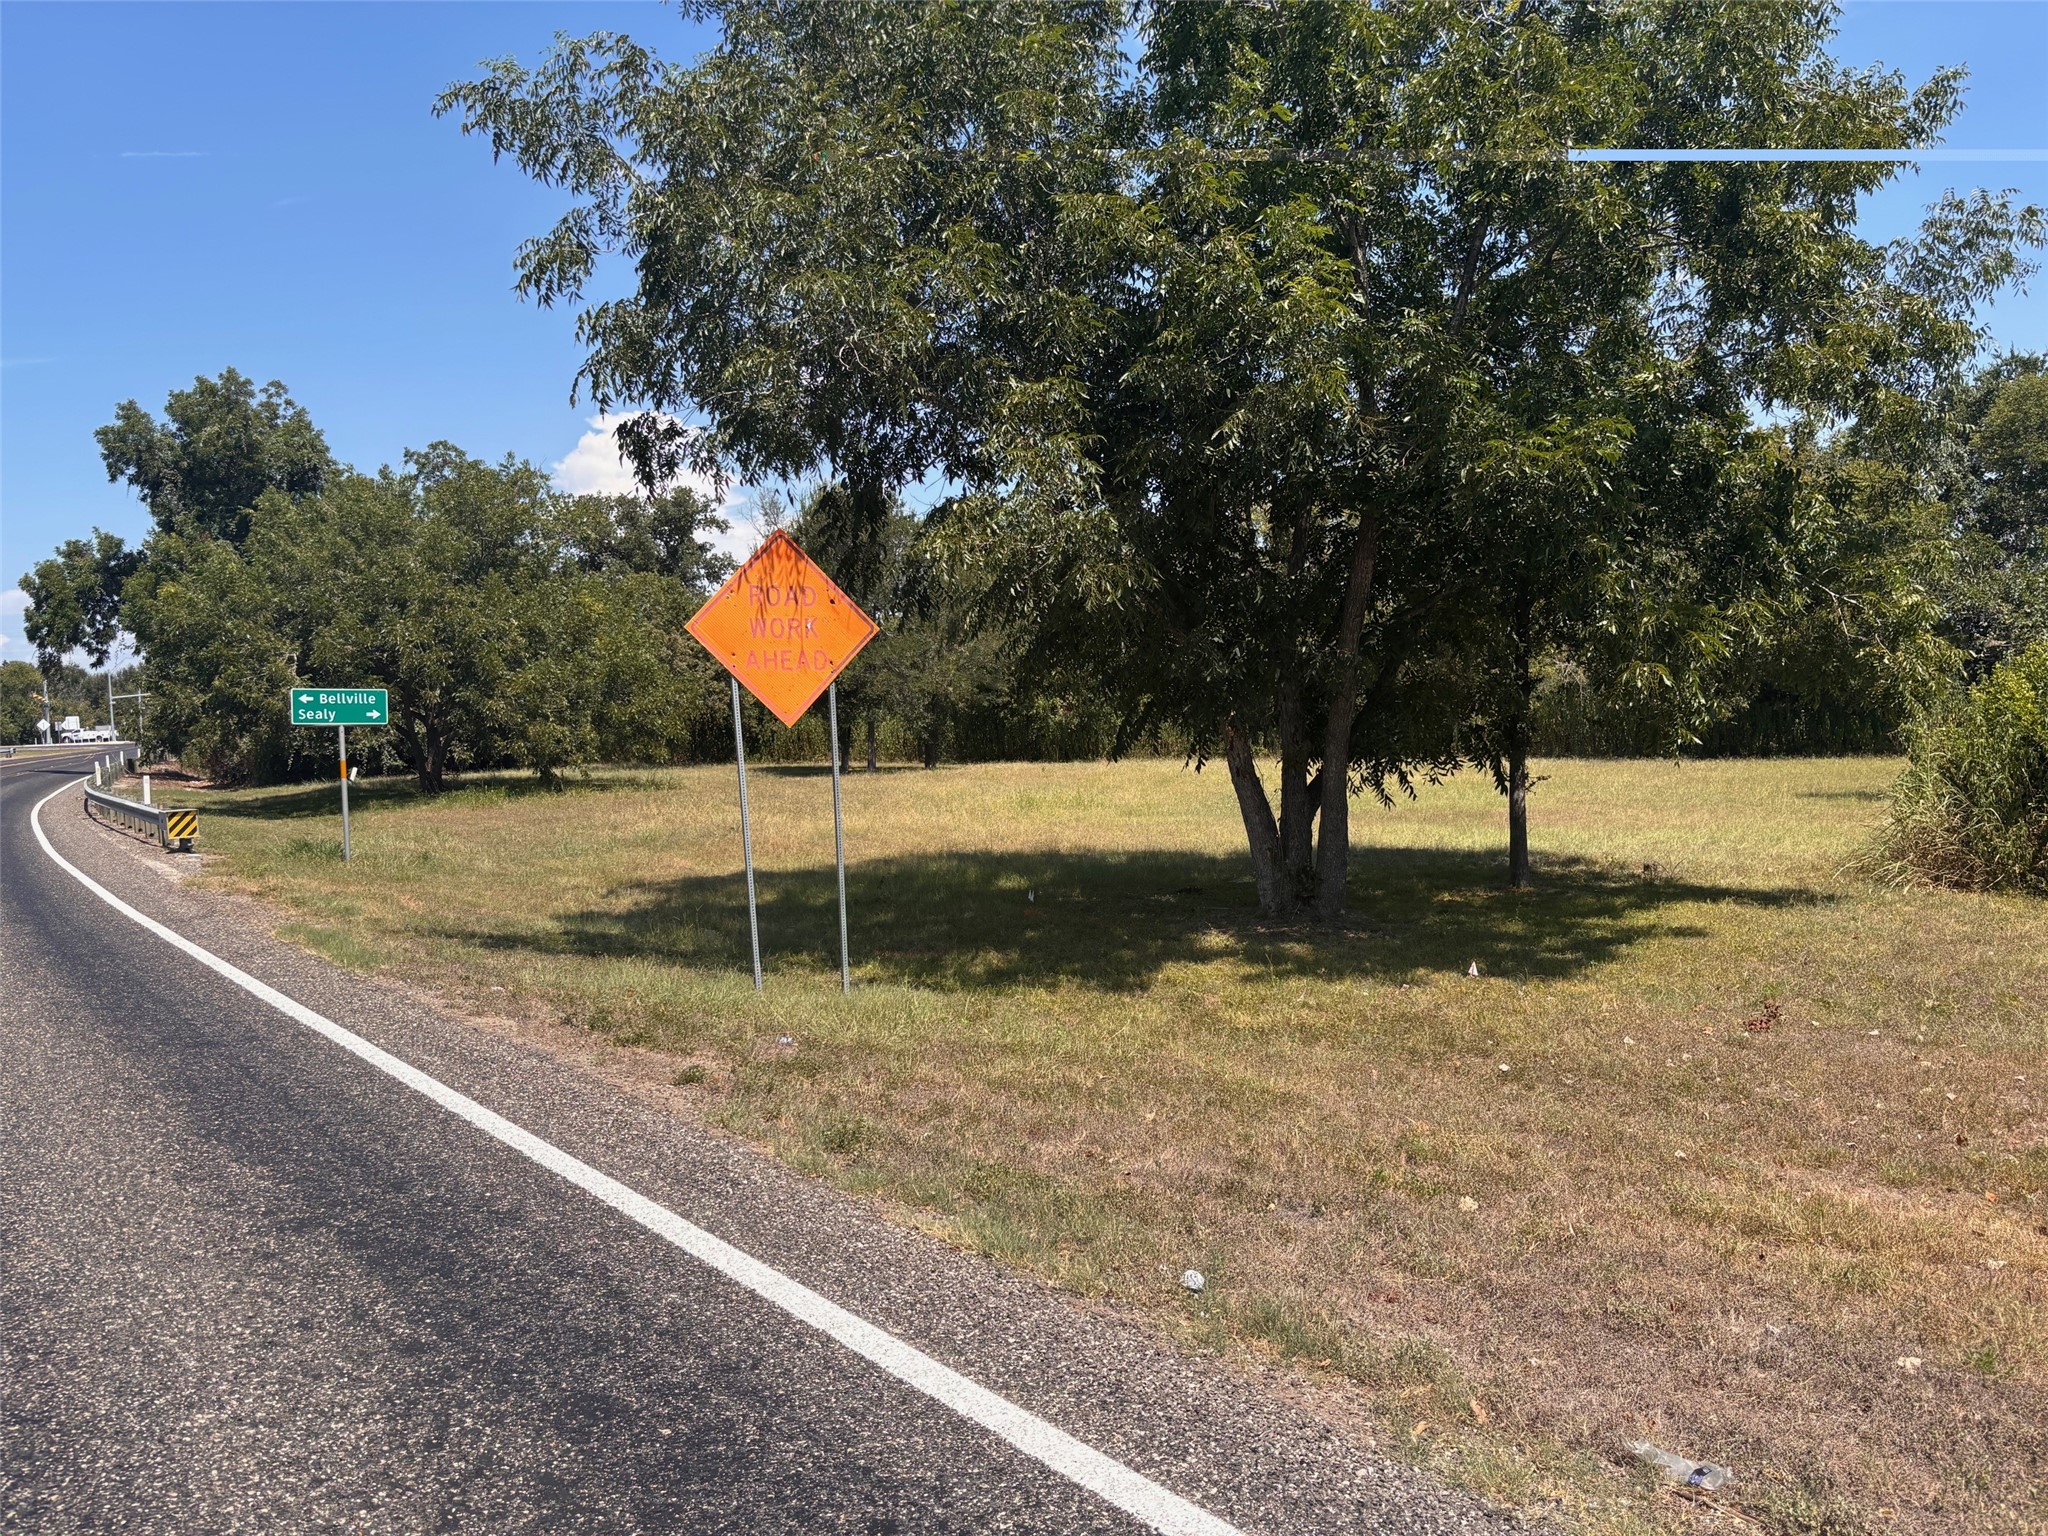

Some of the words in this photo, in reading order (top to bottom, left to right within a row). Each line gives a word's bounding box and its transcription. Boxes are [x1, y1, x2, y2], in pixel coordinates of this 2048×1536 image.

[749, 586, 817, 607] ROAD
[750, 617, 819, 639] WORK
[746, 650, 828, 671] AHEAD
[319, 693, 376, 704] Bellville
[298, 708, 336, 722] Sealy
